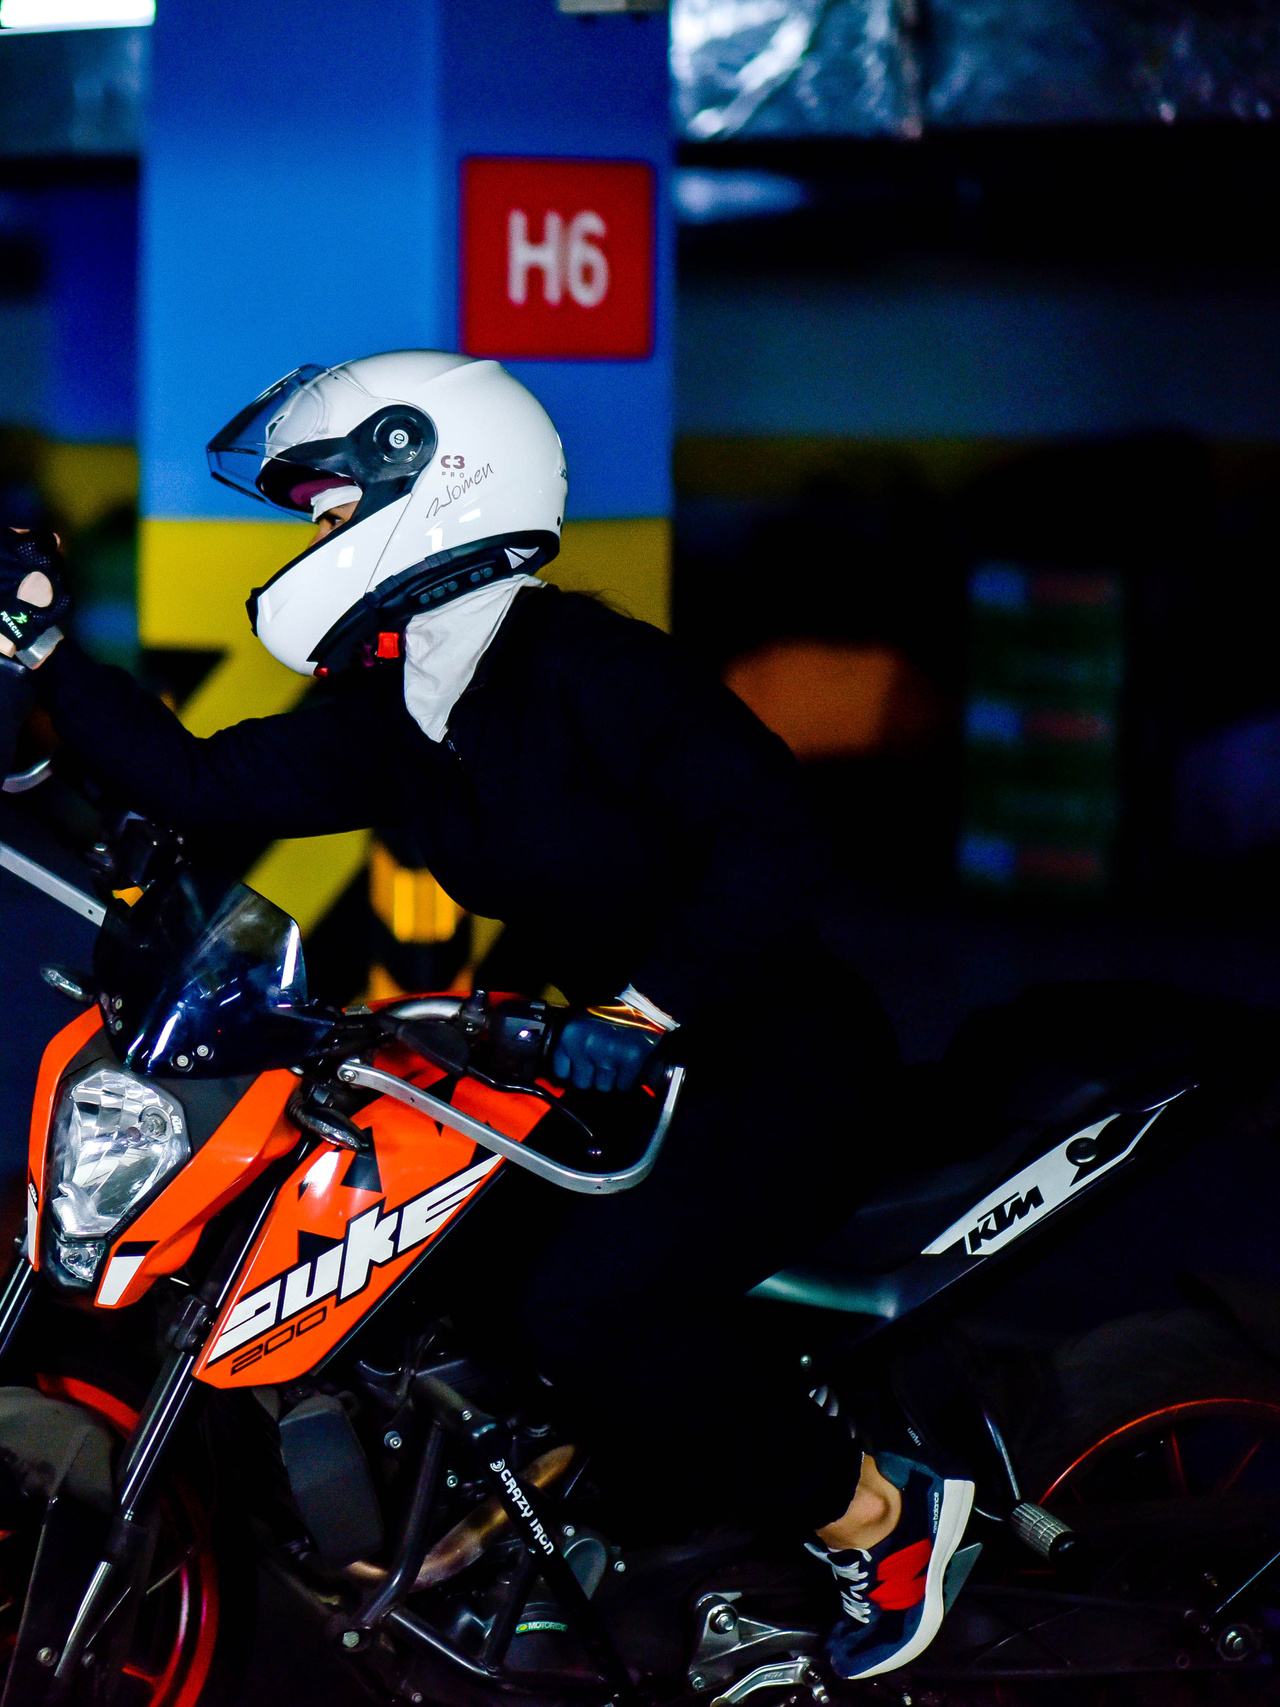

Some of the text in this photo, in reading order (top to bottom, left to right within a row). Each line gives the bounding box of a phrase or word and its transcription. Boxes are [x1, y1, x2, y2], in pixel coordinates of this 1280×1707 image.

[506, 207, 611, 309] H6
[440, 455, 465, 469] C3
[441, 471, 465, 479] PRO
[426, 463, 494, 519] Women
[967, 1185, 1045, 1255] KTM
[230, 1305, 328, 1367] 200
[500, 1468, 534, 1518] CRAZY
[932, 1491, 940, 1521] balance
